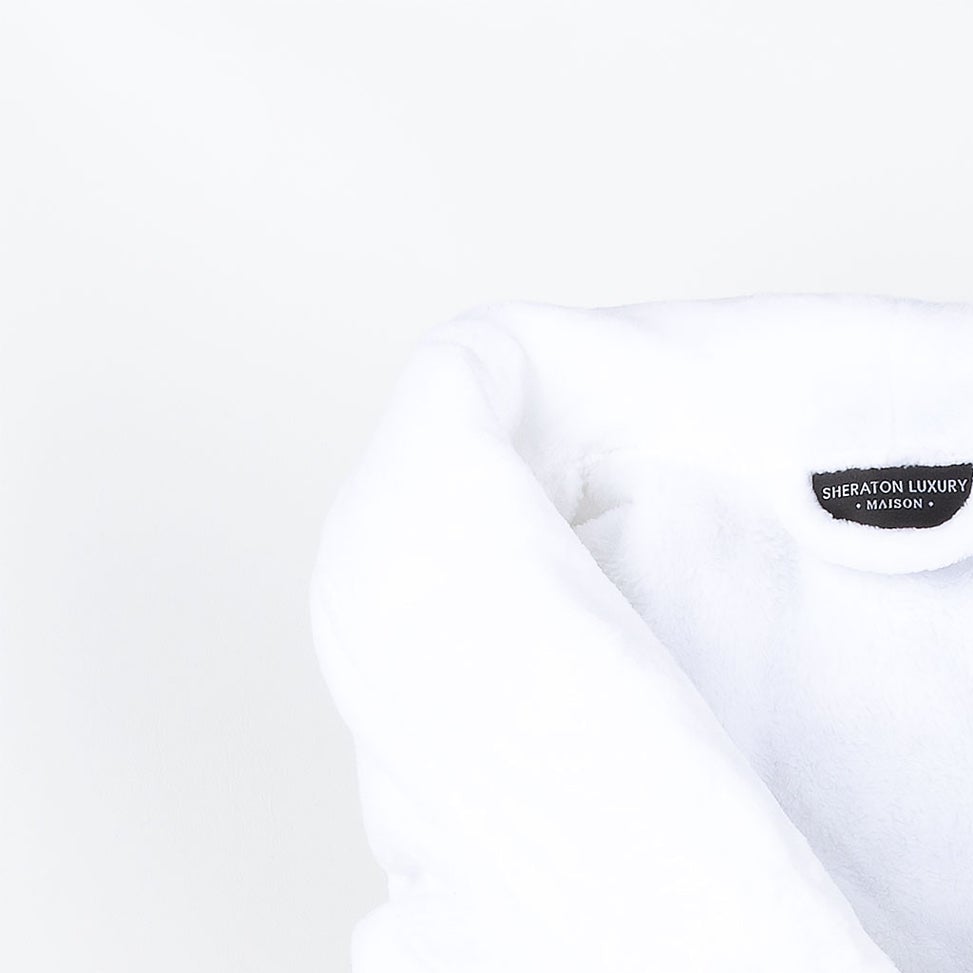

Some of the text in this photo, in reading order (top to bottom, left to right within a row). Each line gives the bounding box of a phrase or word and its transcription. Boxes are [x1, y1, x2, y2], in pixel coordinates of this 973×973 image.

[822, 479, 968, 500] SHERATON LUXURY
[867, 499, 923, 510] MAISON
